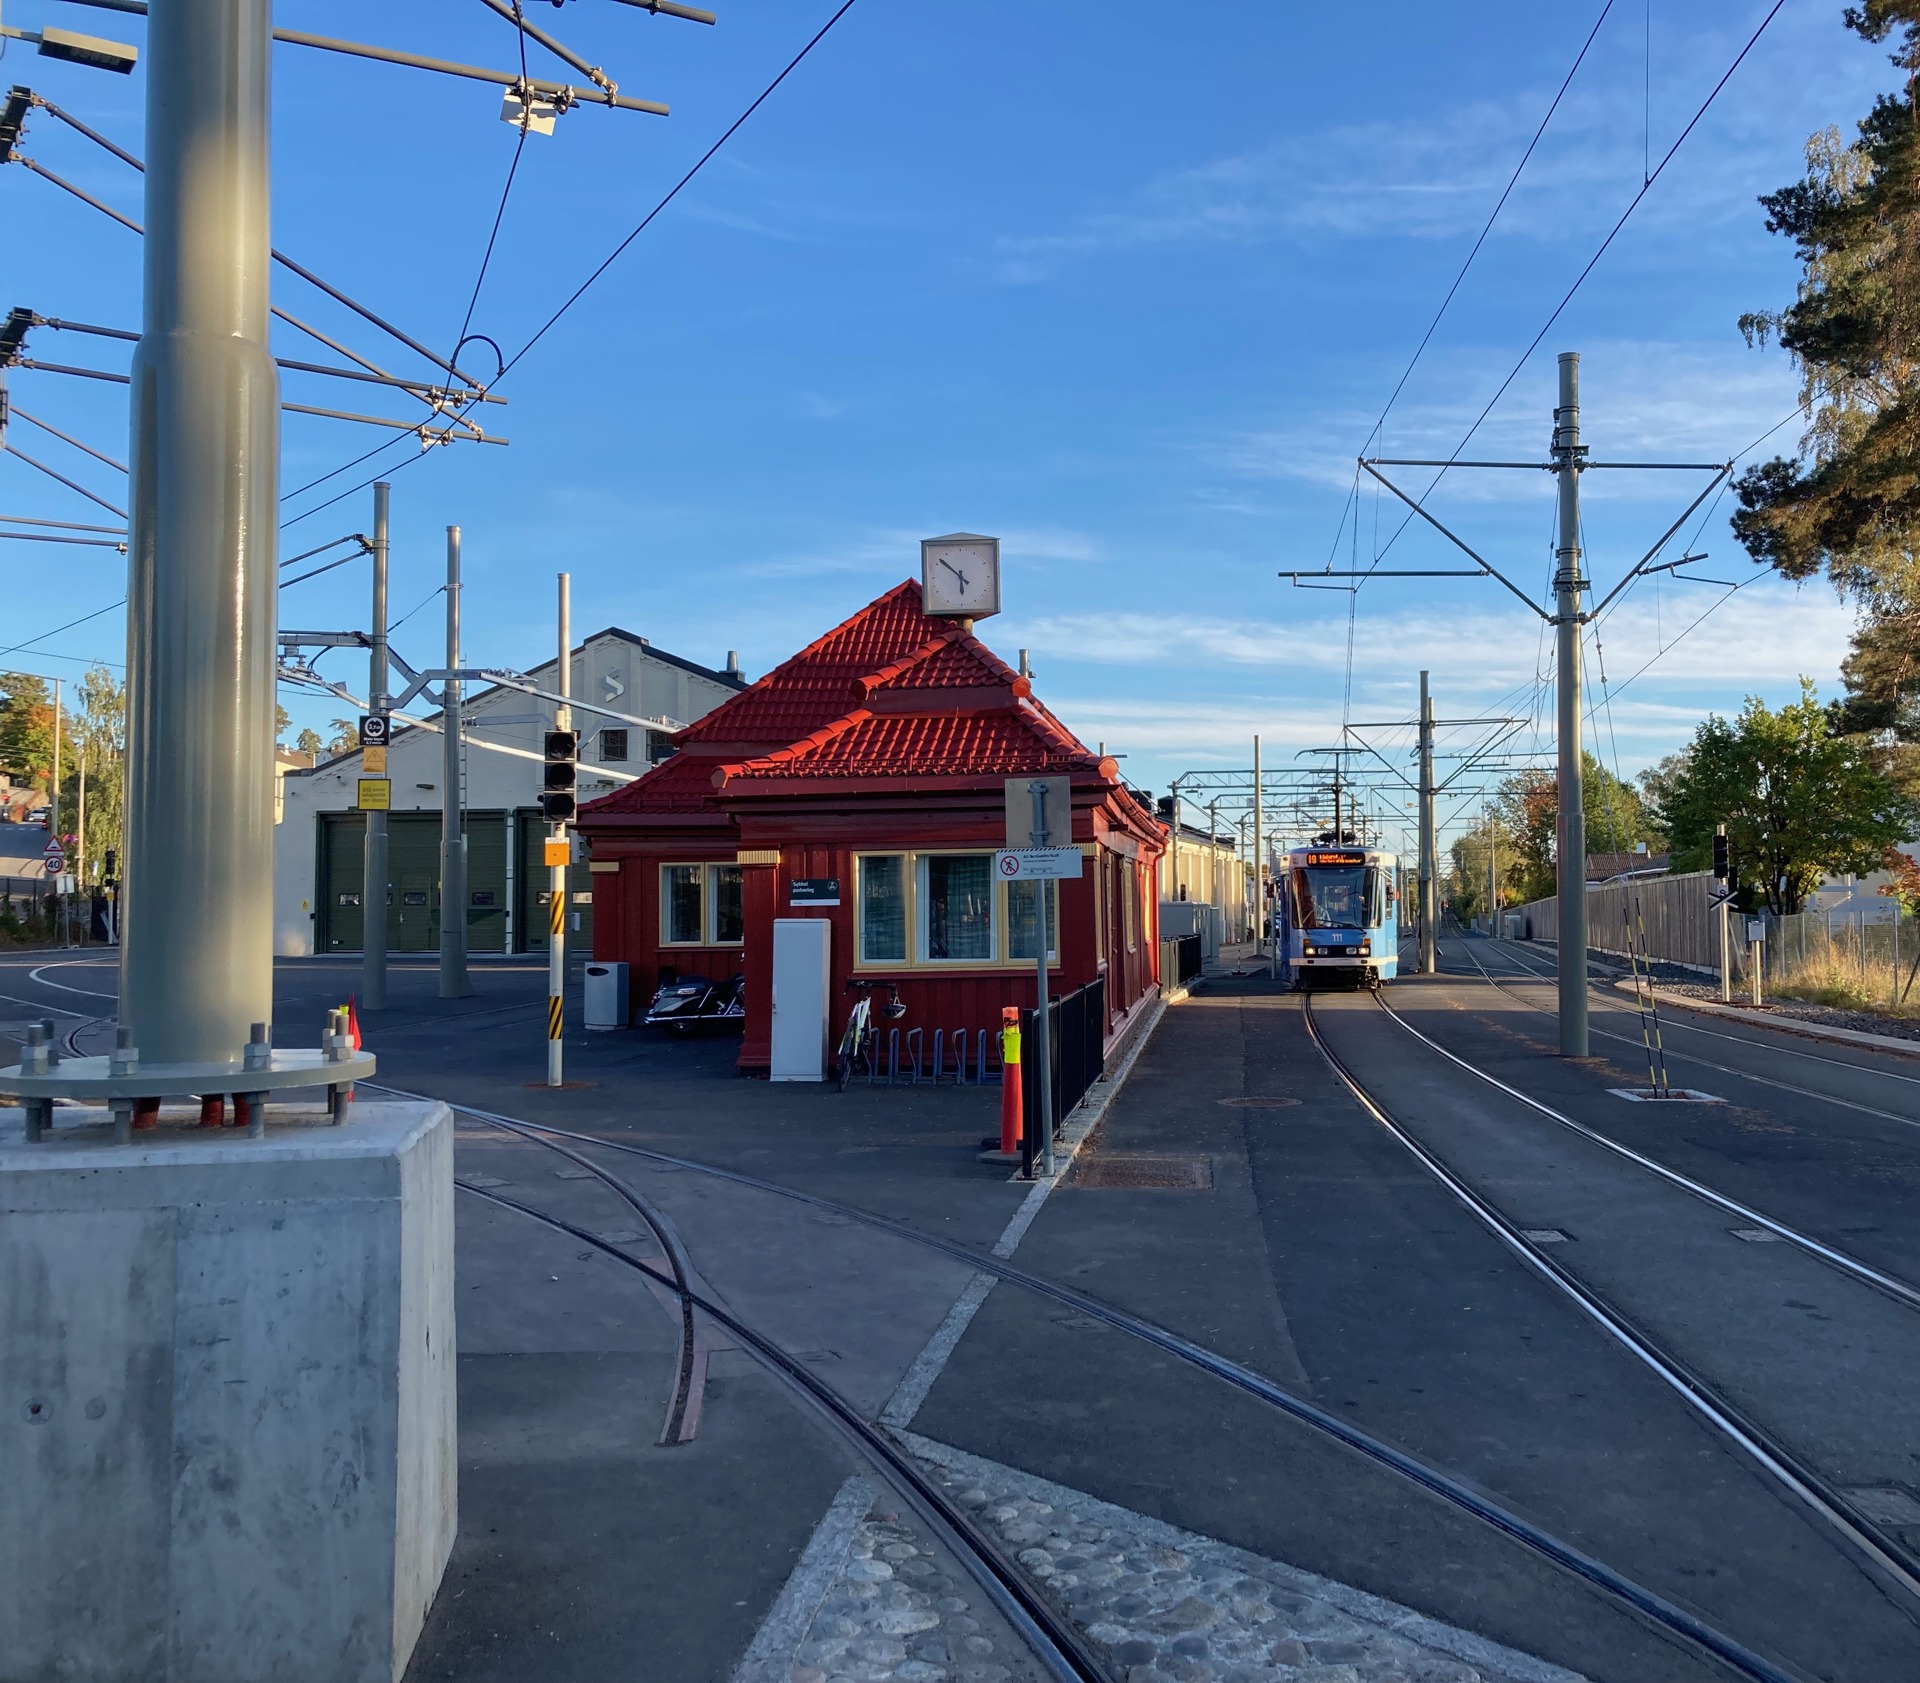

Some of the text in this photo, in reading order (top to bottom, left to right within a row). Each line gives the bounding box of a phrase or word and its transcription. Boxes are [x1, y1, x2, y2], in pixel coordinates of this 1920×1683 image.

[1308, 854, 1317, 864] 19
[47, 860, 60, 869] 40
[1331, 933, 1343, 942] 111
